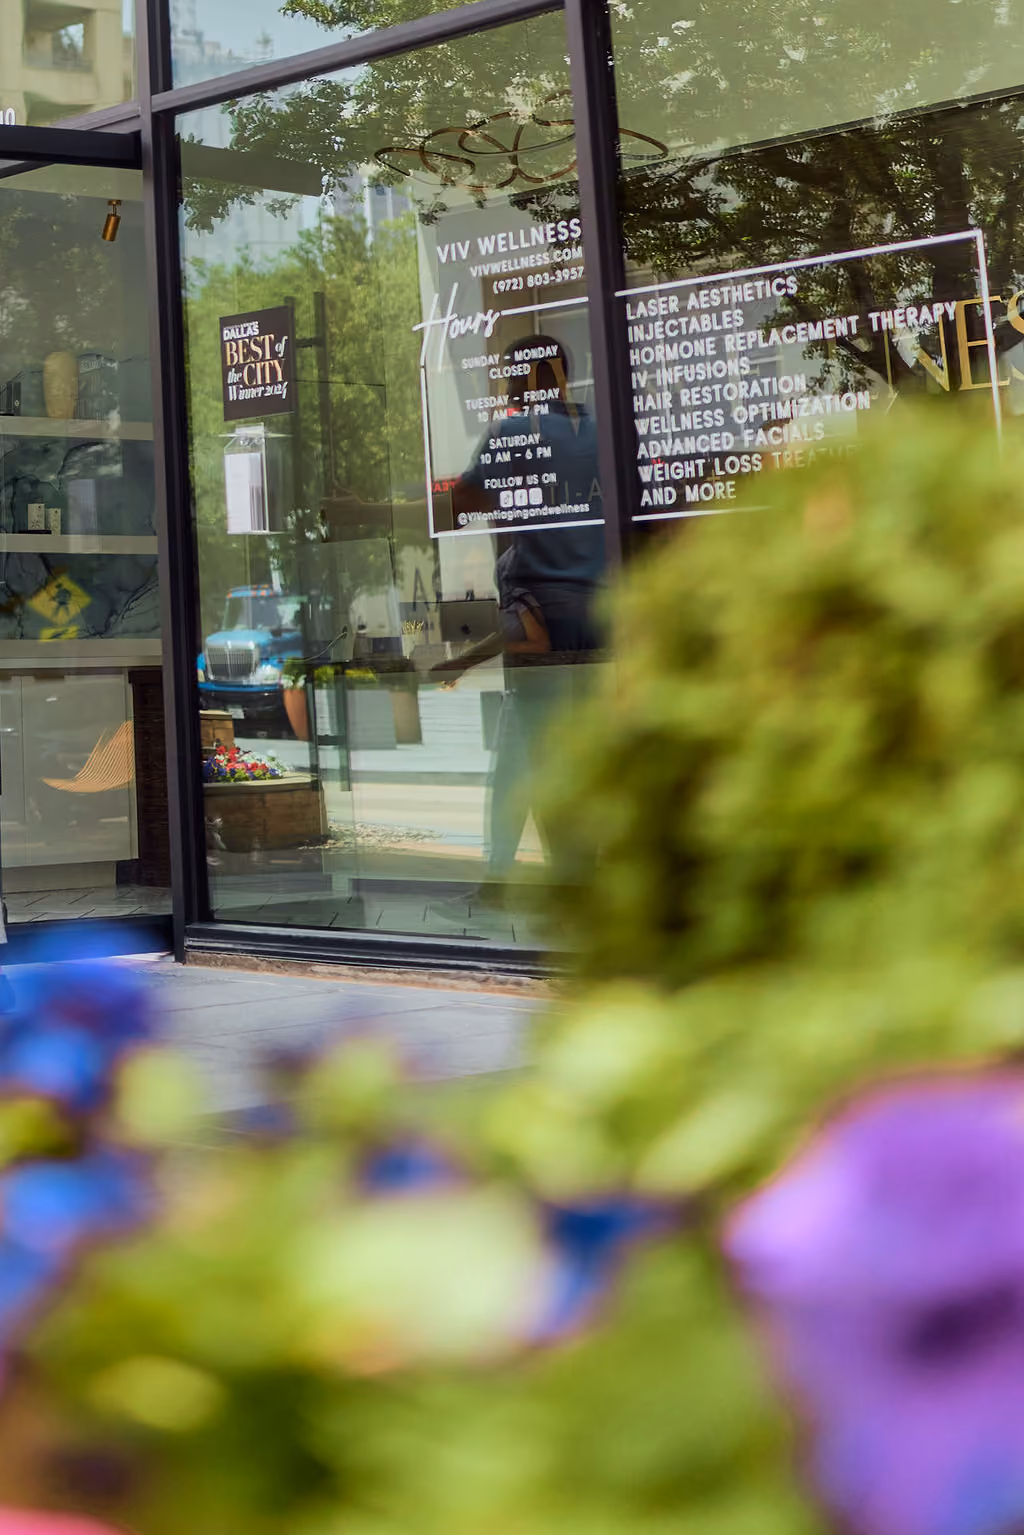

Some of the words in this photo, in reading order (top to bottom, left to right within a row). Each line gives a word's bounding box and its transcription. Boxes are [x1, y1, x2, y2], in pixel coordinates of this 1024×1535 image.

[436, 240, 471, 264] VIV
[477, 218, 582, 256] WELLNESS
[470, 247, 583, 277] VIVWELLNESS.COM
[492, 277, 524, 294] (972)
[527, 266, 585, 288] 803-3957
[626, 295, 680, 321] LASER
[687, 275, 798, 310] AESTHETICS
[223, 324, 259, 341] DALLAS
[412, 282, 502, 373] Hours
[627, 309, 745, 343] INJECTABLES
[629, 336, 717, 366] HORMONE
[725, 314, 860, 353] REPLACEMENT
[868, 300, 958, 332] THERAPY
[225, 334, 275, 366] BEST
[275, 336, 288, 357] of
[461, 354, 501, 369] SUNDAY
[514, 345, 559, 362] MONDAY
[227, 368, 243, 384] the
[243, 358, 286, 386] CITY
[489, 363, 531, 379] CLOSED
[631, 370, 649, 389] IV
[656, 356, 751, 386] INFUSIONS
[228, 384, 265, 401] Winner
[465, 394, 510, 410] TUESDAY
[523, 388, 560, 403] FRIDAY
[633, 391, 673, 413] HAIR
[680, 374, 807, 407] RESTORATION
[493, 409, 508, 420] AM
[533, 403, 550, 415] PM
[634, 409, 724, 435] WELLNESS
[733, 391, 871, 425] OPTIMIZATION
[480, 453, 492, 464] 10
[495, 451, 511, 463] AM
[525, 448, 533, 460] 6
[537, 446, 552, 459] PM
[489, 433, 541, 450] SATURDAY
[636, 432, 734, 459] ADVANCED
[743, 422, 826, 448] FACIALS
[484, 476, 523, 490] FOLLOW
[526, 473, 539, 485] US
[542, 472, 557, 484] ON
[637, 459, 706, 483] WEIGHT
[714, 453, 762, 476] LOSS
[640, 486, 677, 507] AND
[685, 481, 737, 502] MORE
